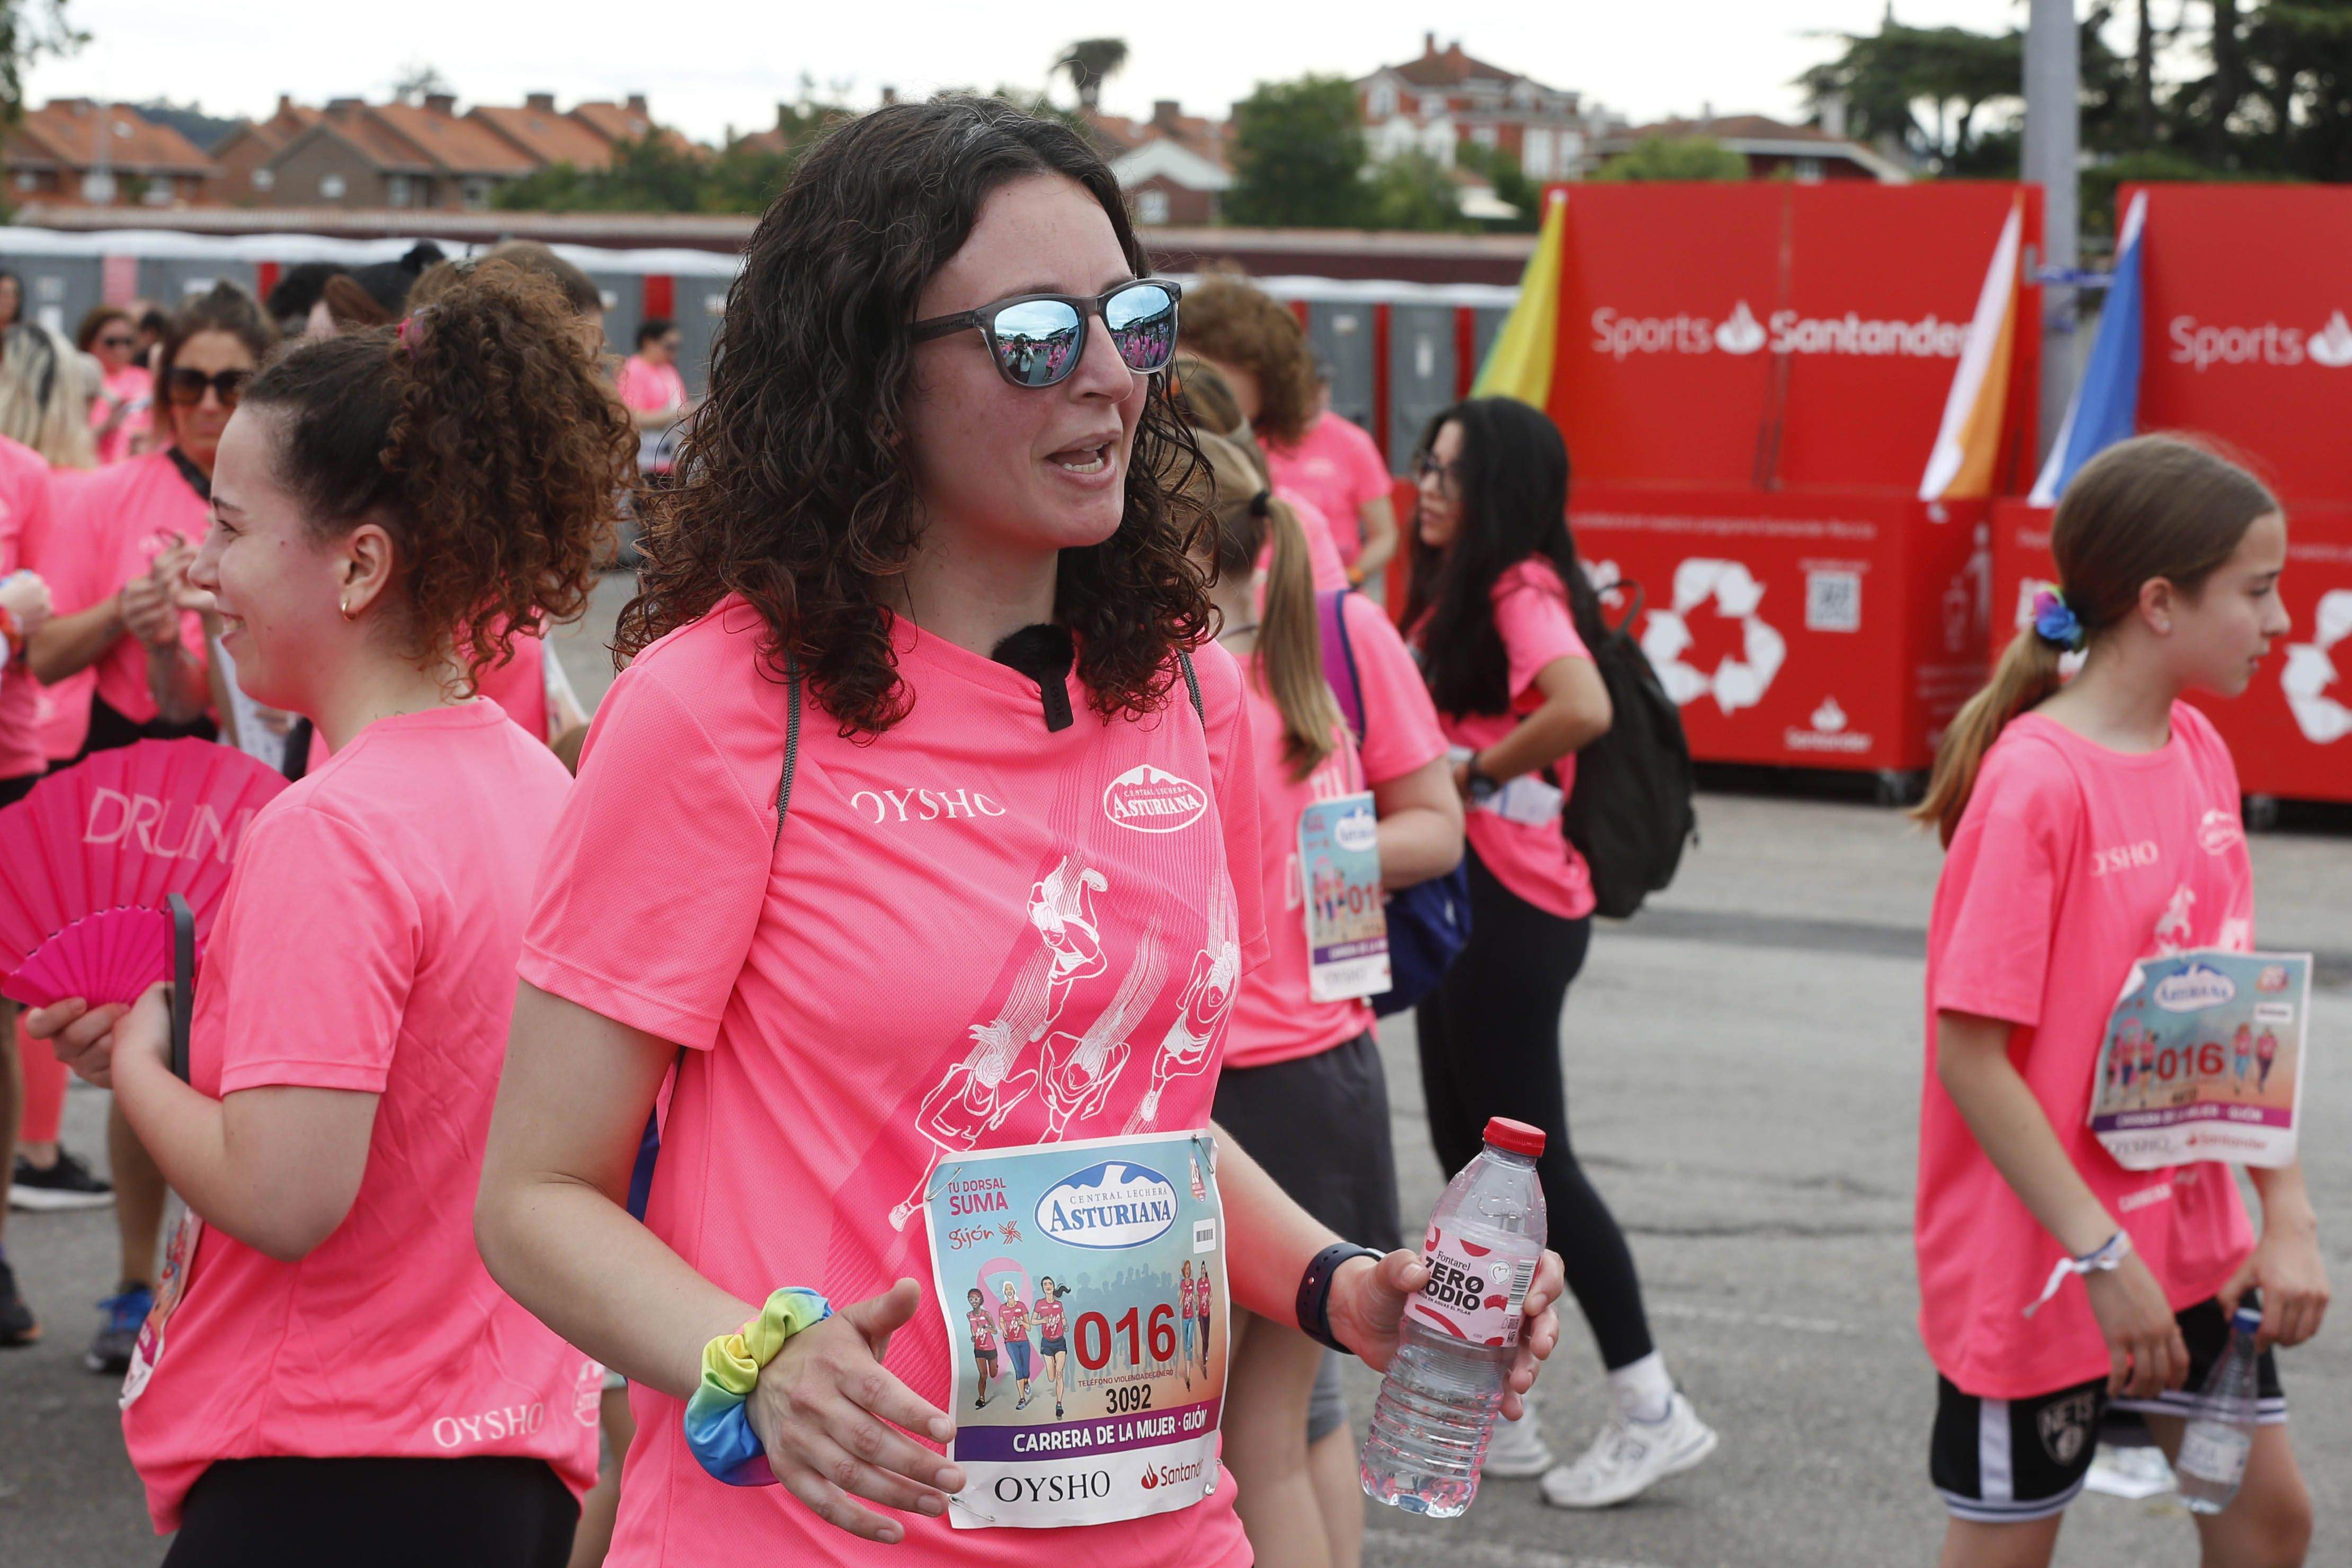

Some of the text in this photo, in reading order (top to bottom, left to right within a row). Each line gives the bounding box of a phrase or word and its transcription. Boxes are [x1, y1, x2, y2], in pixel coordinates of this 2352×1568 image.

[1591, 307, 1712, 361] Sports
[2169, 315, 2303, 372] Sports
[1784, 726, 1874, 754] Santander
[1114, 793, 1202, 819] ASTURIANA
[1124, 786, 1188, 797] CENTRAL LECHERA
[2158, 1043, 2224, 1081] 016
[948, 1178, 1006, 1193] TU DORSAL
[1070, 1187, 1168, 1204] CENTRAL LECHERA
[950, 1191, 1009, 1216] SUMA
[1050, 1199, 1172, 1232] ASTURIANA
[949, 1225, 995, 1250] gijón
[1437, 1250, 1471, 1271] Fontarel
[1422, 1279, 1481, 1311] ODIO
[1435, 1299, 1449, 1308] AGUAS
[1073, 1303, 1176, 1370] 016
[1078, 1378, 1112, 1387] TELÉFONO
[1114, 1373, 1145, 1383] VIOLENCIA
[1106, 1384, 1151, 1414] 3092
[432, 1402, 545, 1448] OYSHO
[1013, 1405, 1207, 1453] CARRERA DE LA MUJER GIJÓN
[994, 1471, 1110, 1503] OYSHO
